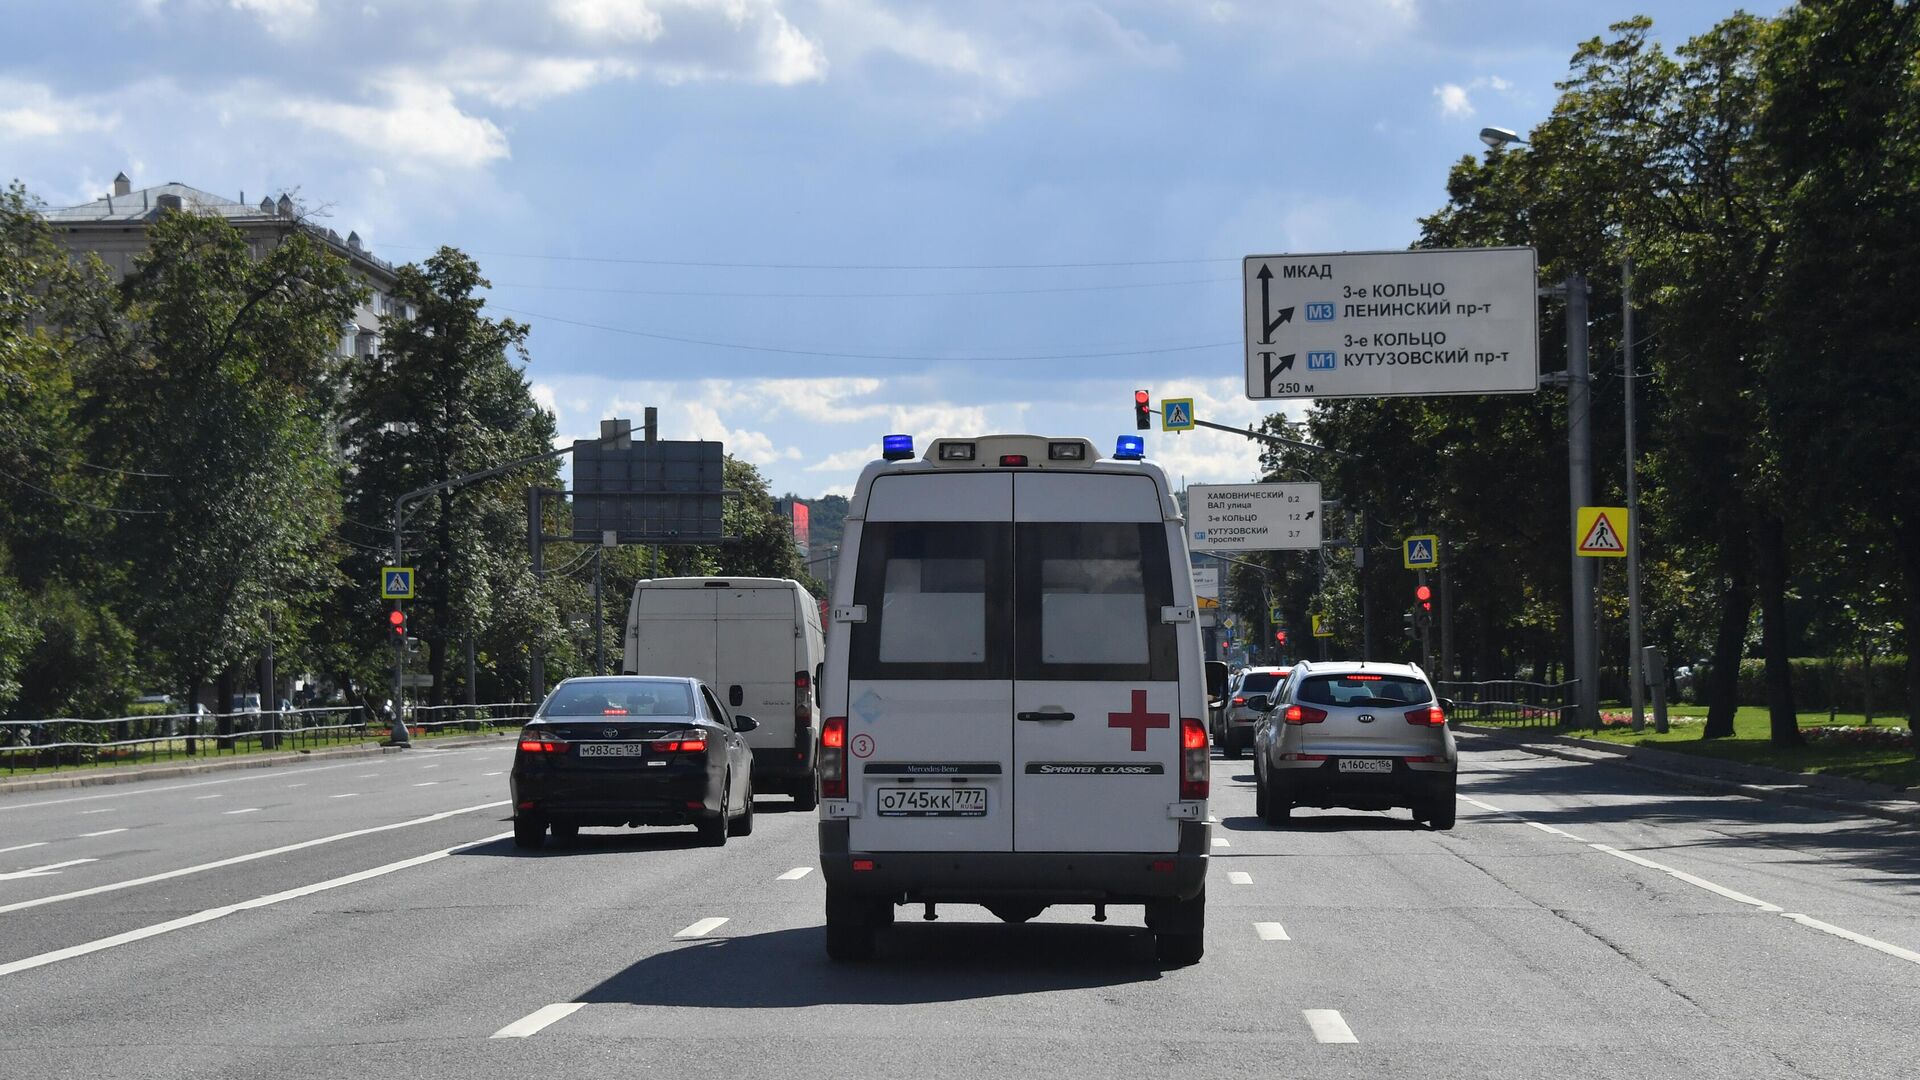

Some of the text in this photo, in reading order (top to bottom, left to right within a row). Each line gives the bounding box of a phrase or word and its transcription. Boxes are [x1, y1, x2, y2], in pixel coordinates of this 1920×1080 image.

[1284, 264, 1332, 279] МКАД
[1344, 283, 1445, 298] 3-е КОЛЬЦО
[1307, 300, 1492, 319] М3 ЛЕНИНСКИЙ пр-т
[1344, 332, 1446, 347] 3-е КОЛЬЦО
[1311, 348, 1509, 368] М1 КУТУЗОВСКИЙ пр-т
[1278, 383, 1314, 393] 250 м
[1207, 491, 1284, 500] ХАМОВНИЧЕСКИЙ
[1226, 503, 1252, 511] улица
[1222, 514, 1258, 523] КОЛЬЦО
[1289, 513, 1301, 521] 1.2
[1207, 528, 1269, 536] КУТУЗОВСКИЙ
[1208, 536, 1245, 544] проспект
[859, 739, 867, 752] 3
[907, 765, 959, 773] Mercedes-Benz
[1101, 766, 1152, 774] CLASSIC
[954, 791, 981, 804] 777
